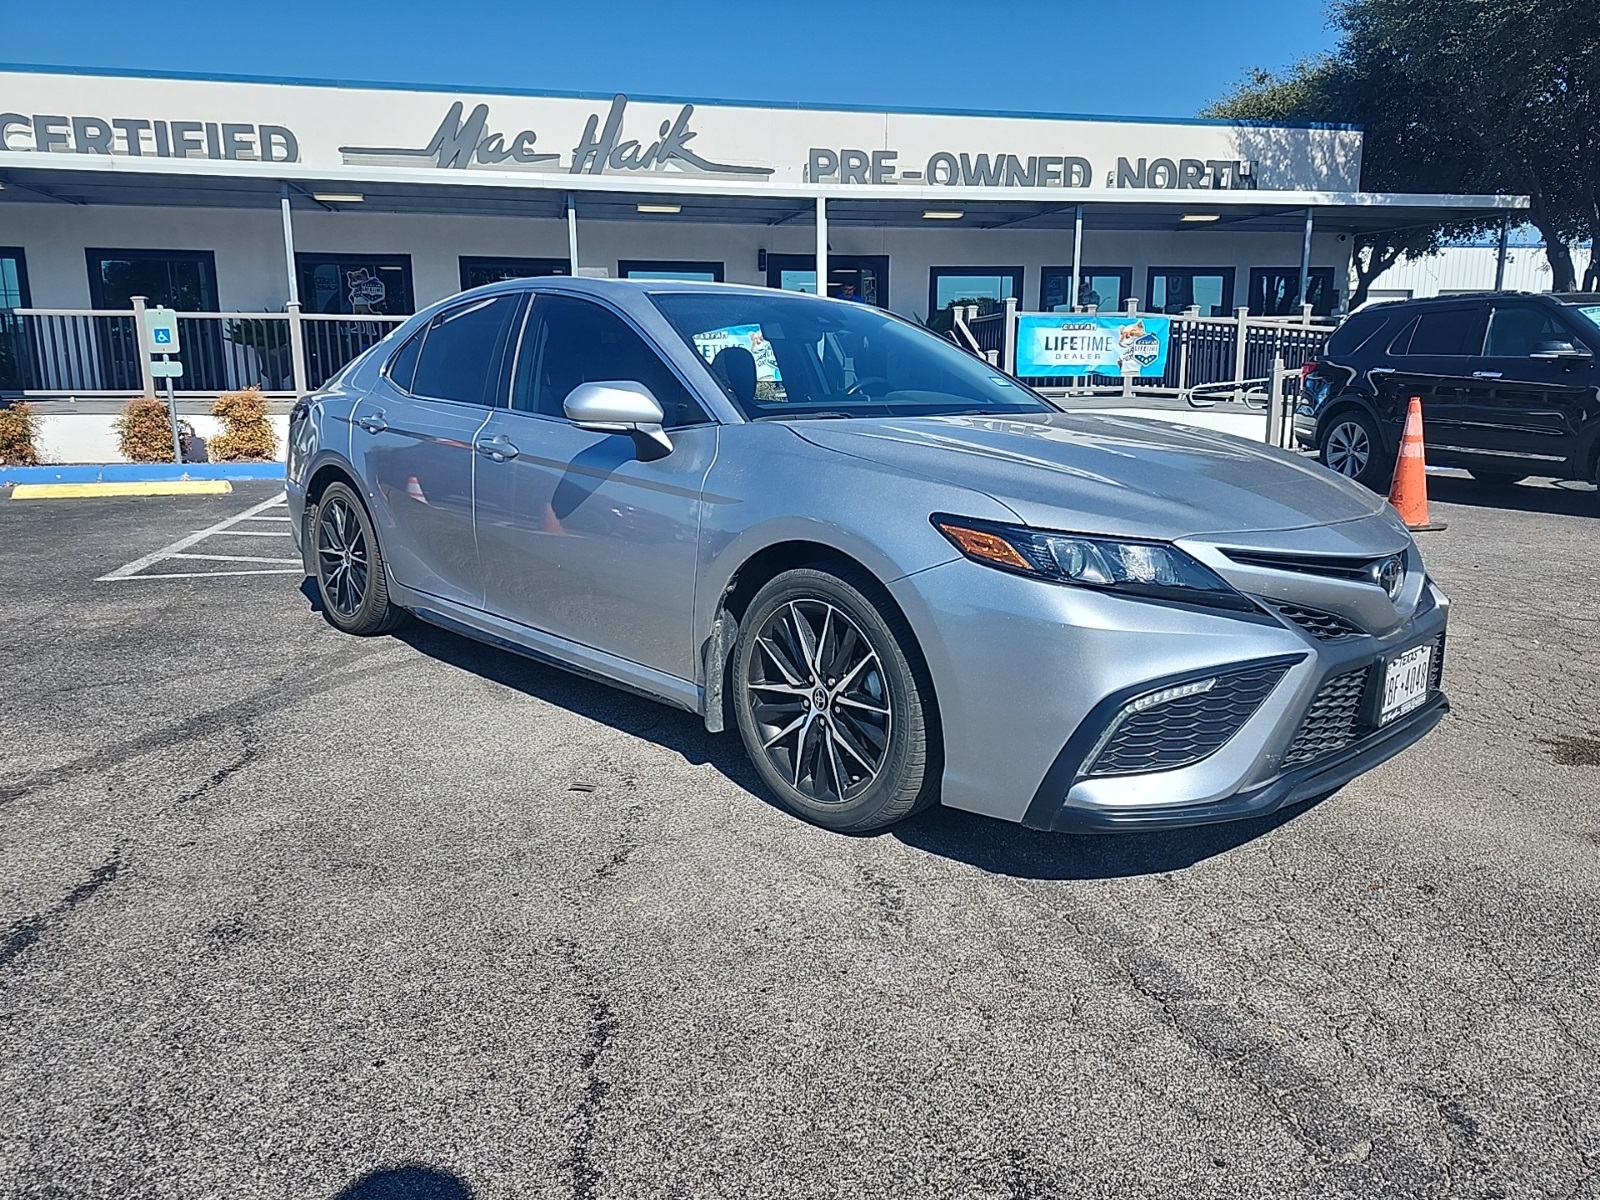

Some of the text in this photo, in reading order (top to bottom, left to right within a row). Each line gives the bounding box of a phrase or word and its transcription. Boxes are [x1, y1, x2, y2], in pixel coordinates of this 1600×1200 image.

[0, 113, 300, 163] CERTIFIED
[338, 93, 775, 175] Mac Haik
[808, 147, 1258, 190] PRE-OWNED NORTH
[1044, 336, 1113, 352] LIFETIME
[1400, 652, 1418, 667] TEXAS
